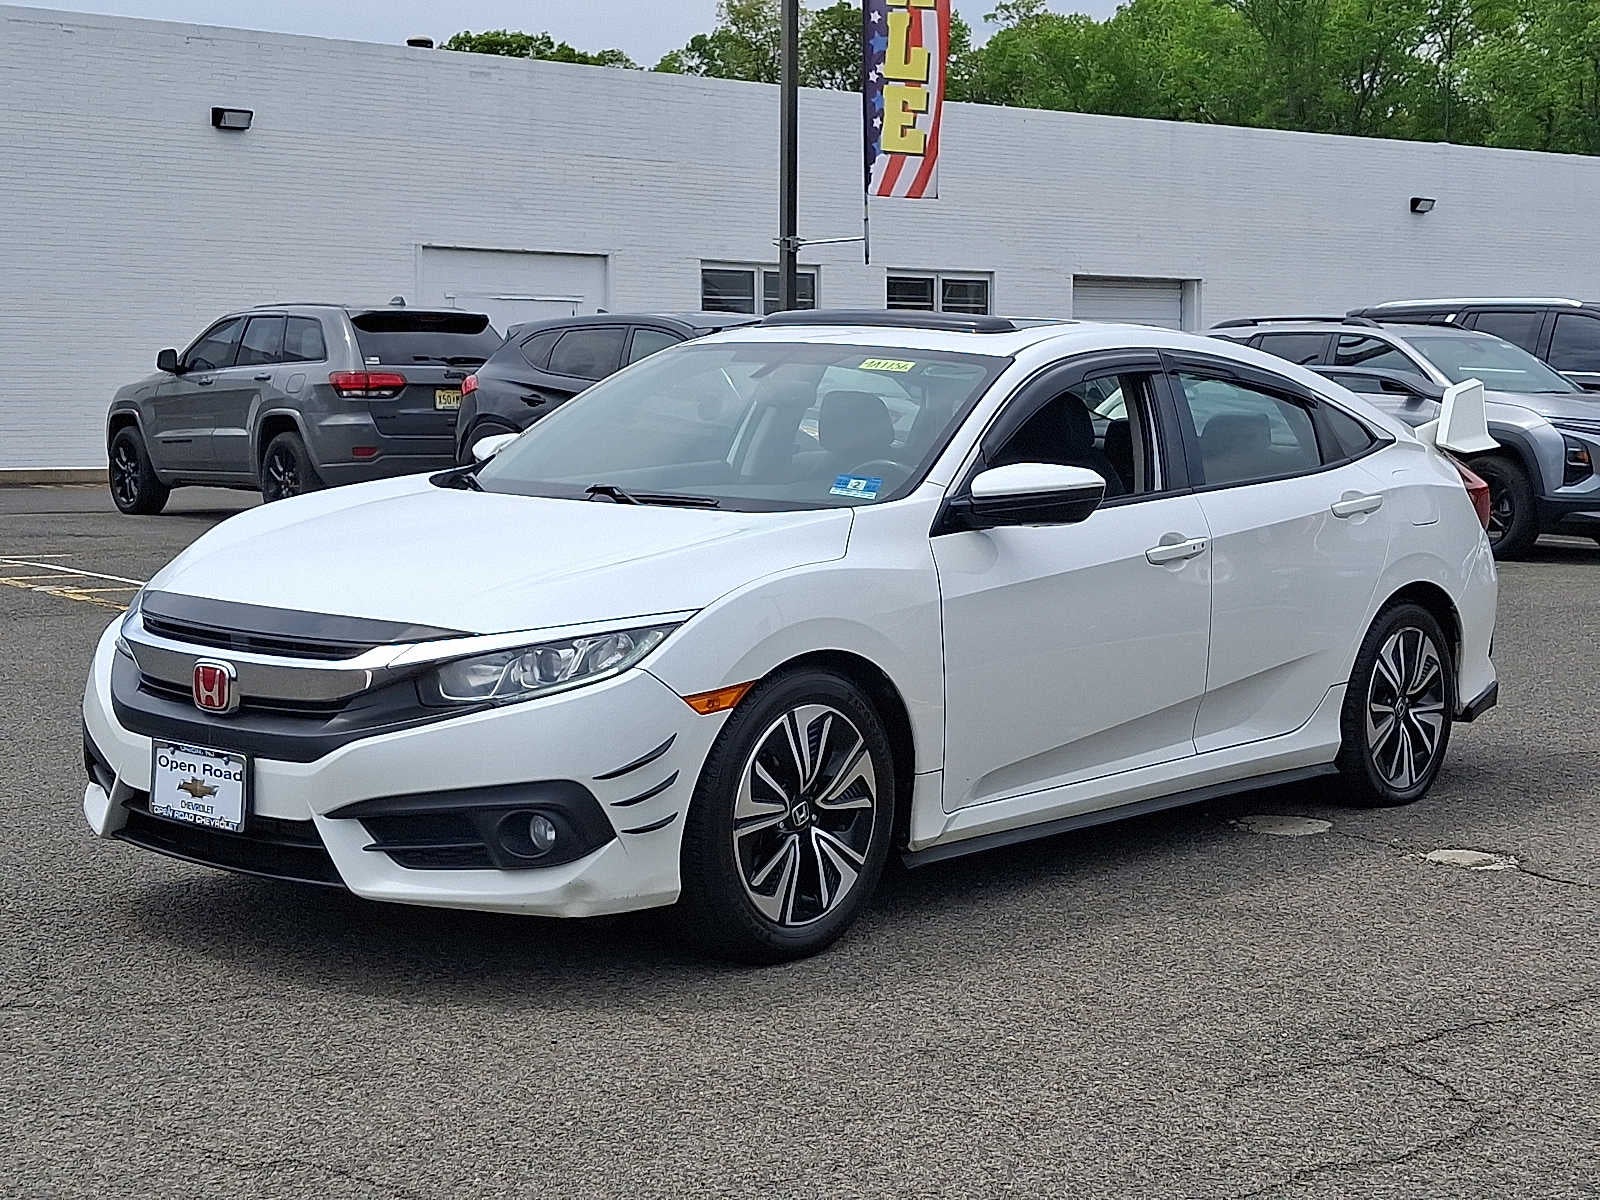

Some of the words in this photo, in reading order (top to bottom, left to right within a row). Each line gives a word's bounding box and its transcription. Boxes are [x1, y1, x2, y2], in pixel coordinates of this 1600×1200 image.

[880, 0, 935, 155] LE
[158, 755, 197, 773] Open
[202, 764, 243, 782] Road
[153, 806, 173, 818] OPEN
[174, 811, 195, 822] ROAD
[195, 815, 238, 830] CHEVROLET
[180, 800, 215, 814] CHEVROLET
